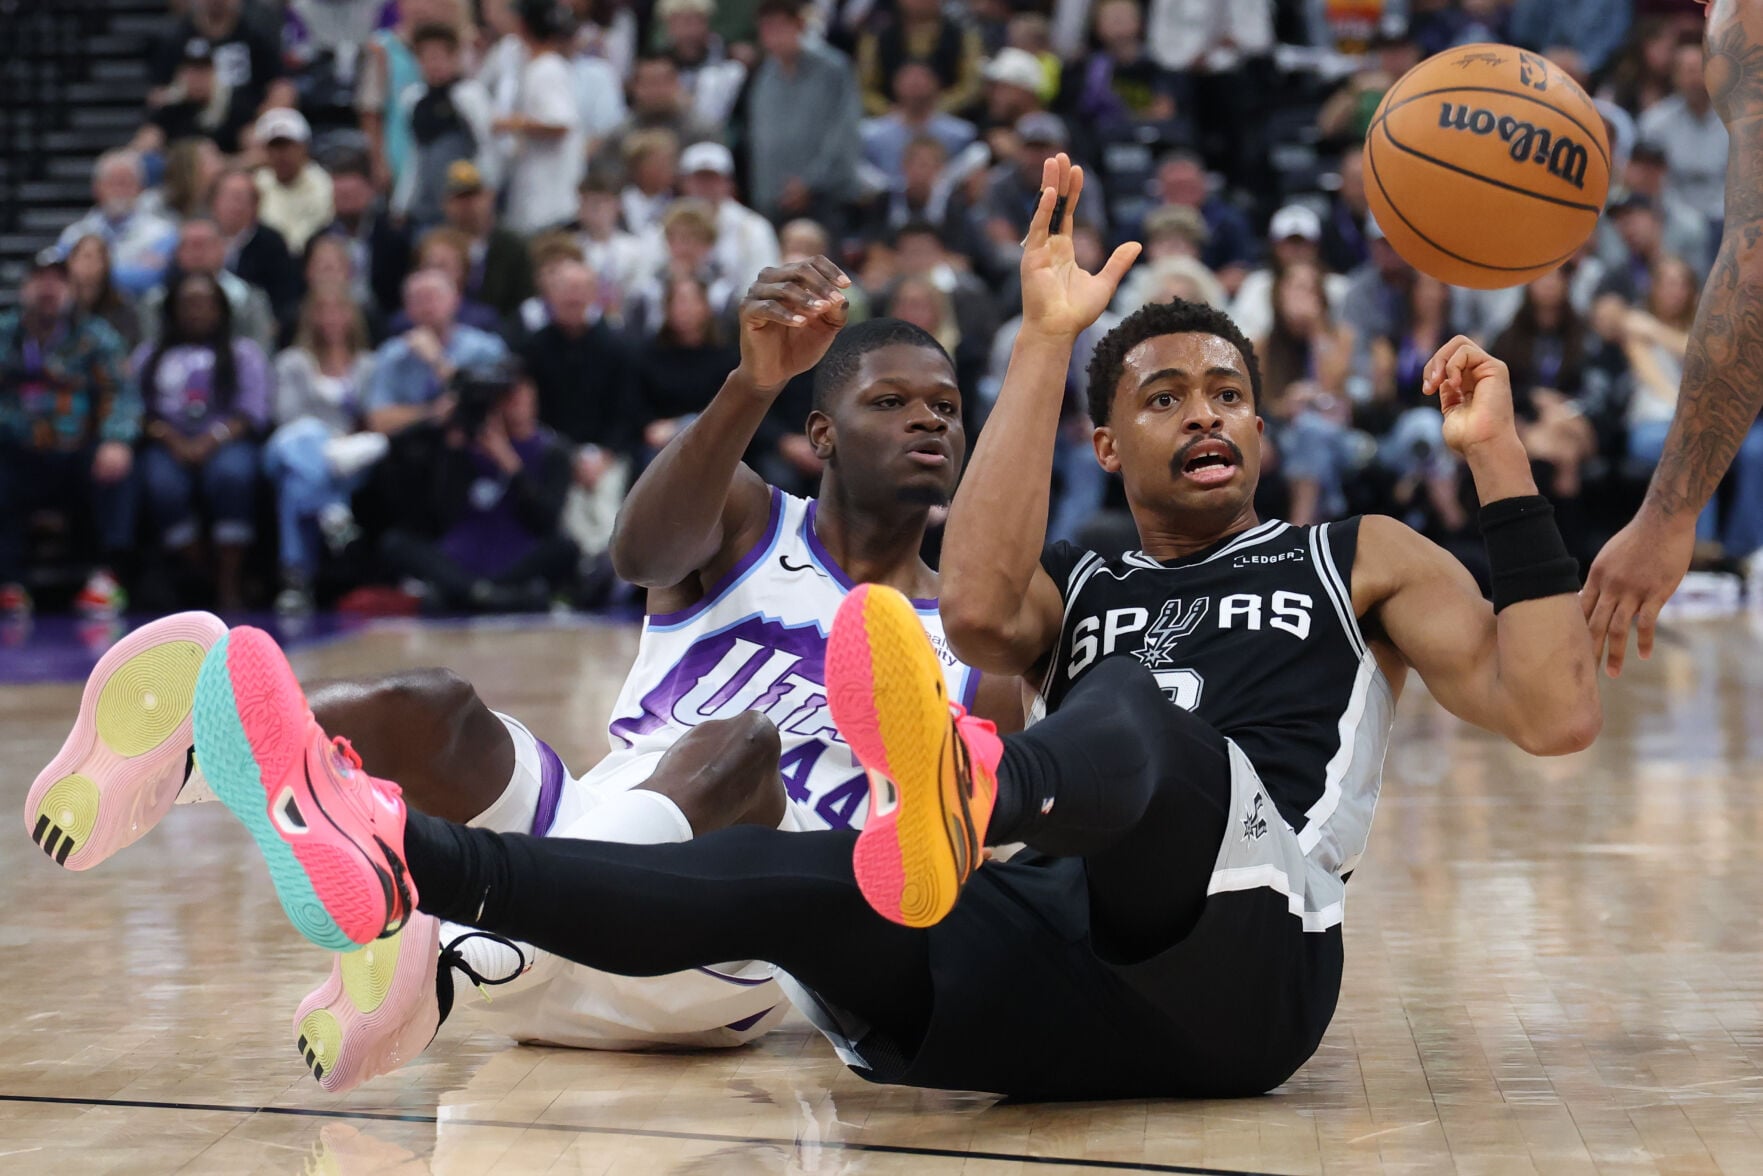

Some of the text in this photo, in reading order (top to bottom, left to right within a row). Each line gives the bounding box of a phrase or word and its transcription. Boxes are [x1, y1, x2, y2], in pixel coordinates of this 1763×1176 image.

[1438, 102, 1588, 190] Wilson
[1241, 551, 1296, 564] LEDGER
[1067, 590, 1314, 680] SPURS
[779, 737, 870, 830] 44
